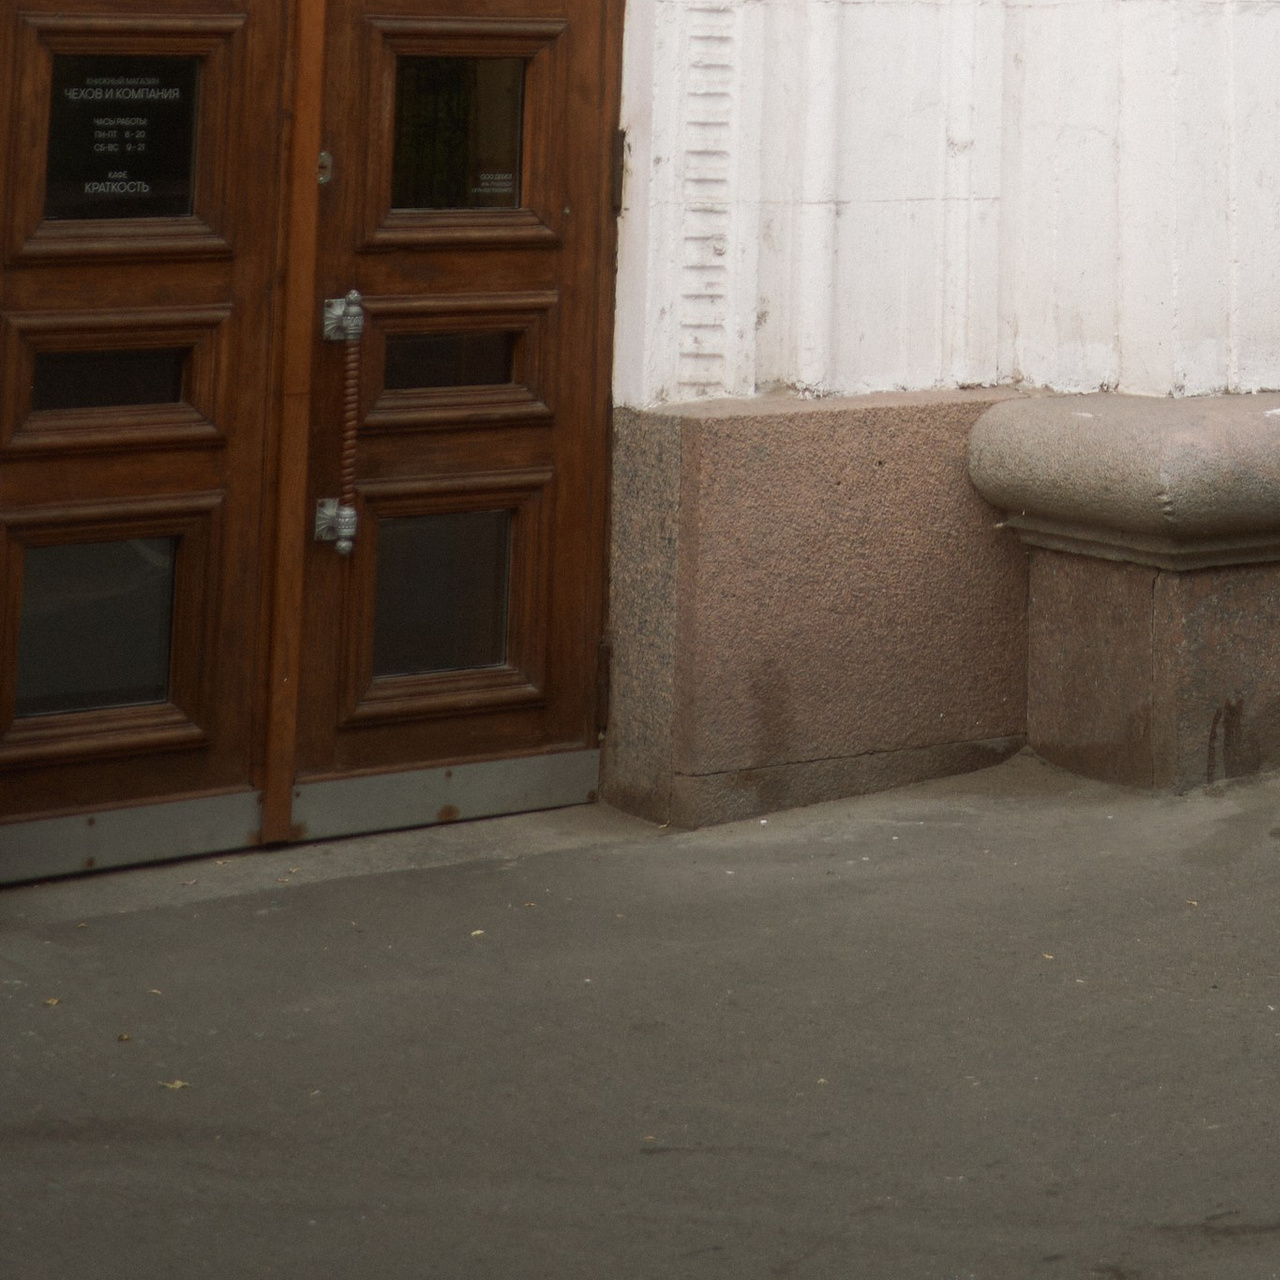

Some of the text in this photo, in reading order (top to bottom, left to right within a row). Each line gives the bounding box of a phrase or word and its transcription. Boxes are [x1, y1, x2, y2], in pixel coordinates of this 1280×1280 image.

[64, 88, 180, 99] ЧЕХОВ И КОМПАНИЯ
[94, 143, 119, 151] СБ-ВС
[108, 171, 128, 179] КАФЕ
[84, 181, 150, 193] КРАТКОСТЬ
